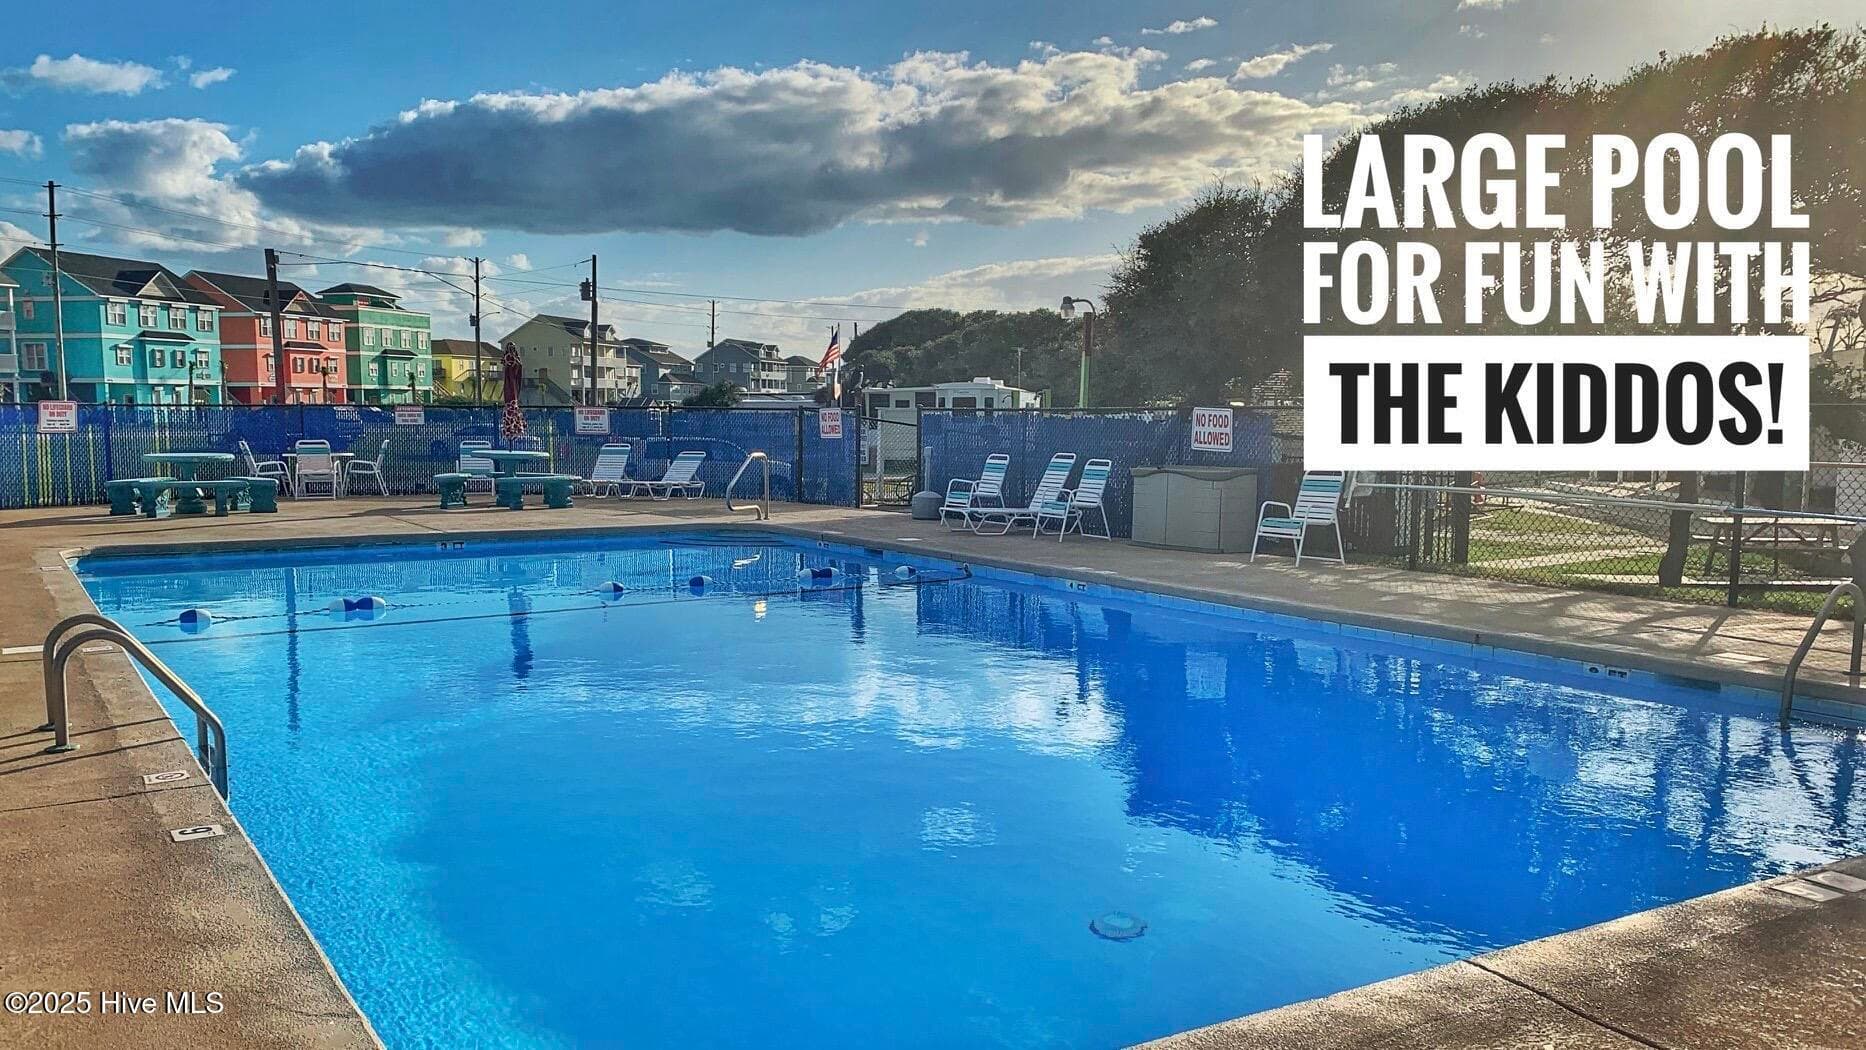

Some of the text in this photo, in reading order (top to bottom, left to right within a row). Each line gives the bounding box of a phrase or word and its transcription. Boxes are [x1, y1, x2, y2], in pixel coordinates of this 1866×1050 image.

[821, 412, 839, 422] NO FOOD
[1195, 413, 1229, 428] NO FOOD
[822, 424, 840, 434] ALLOWED
[1194, 431, 1230, 446] ALLOWED
